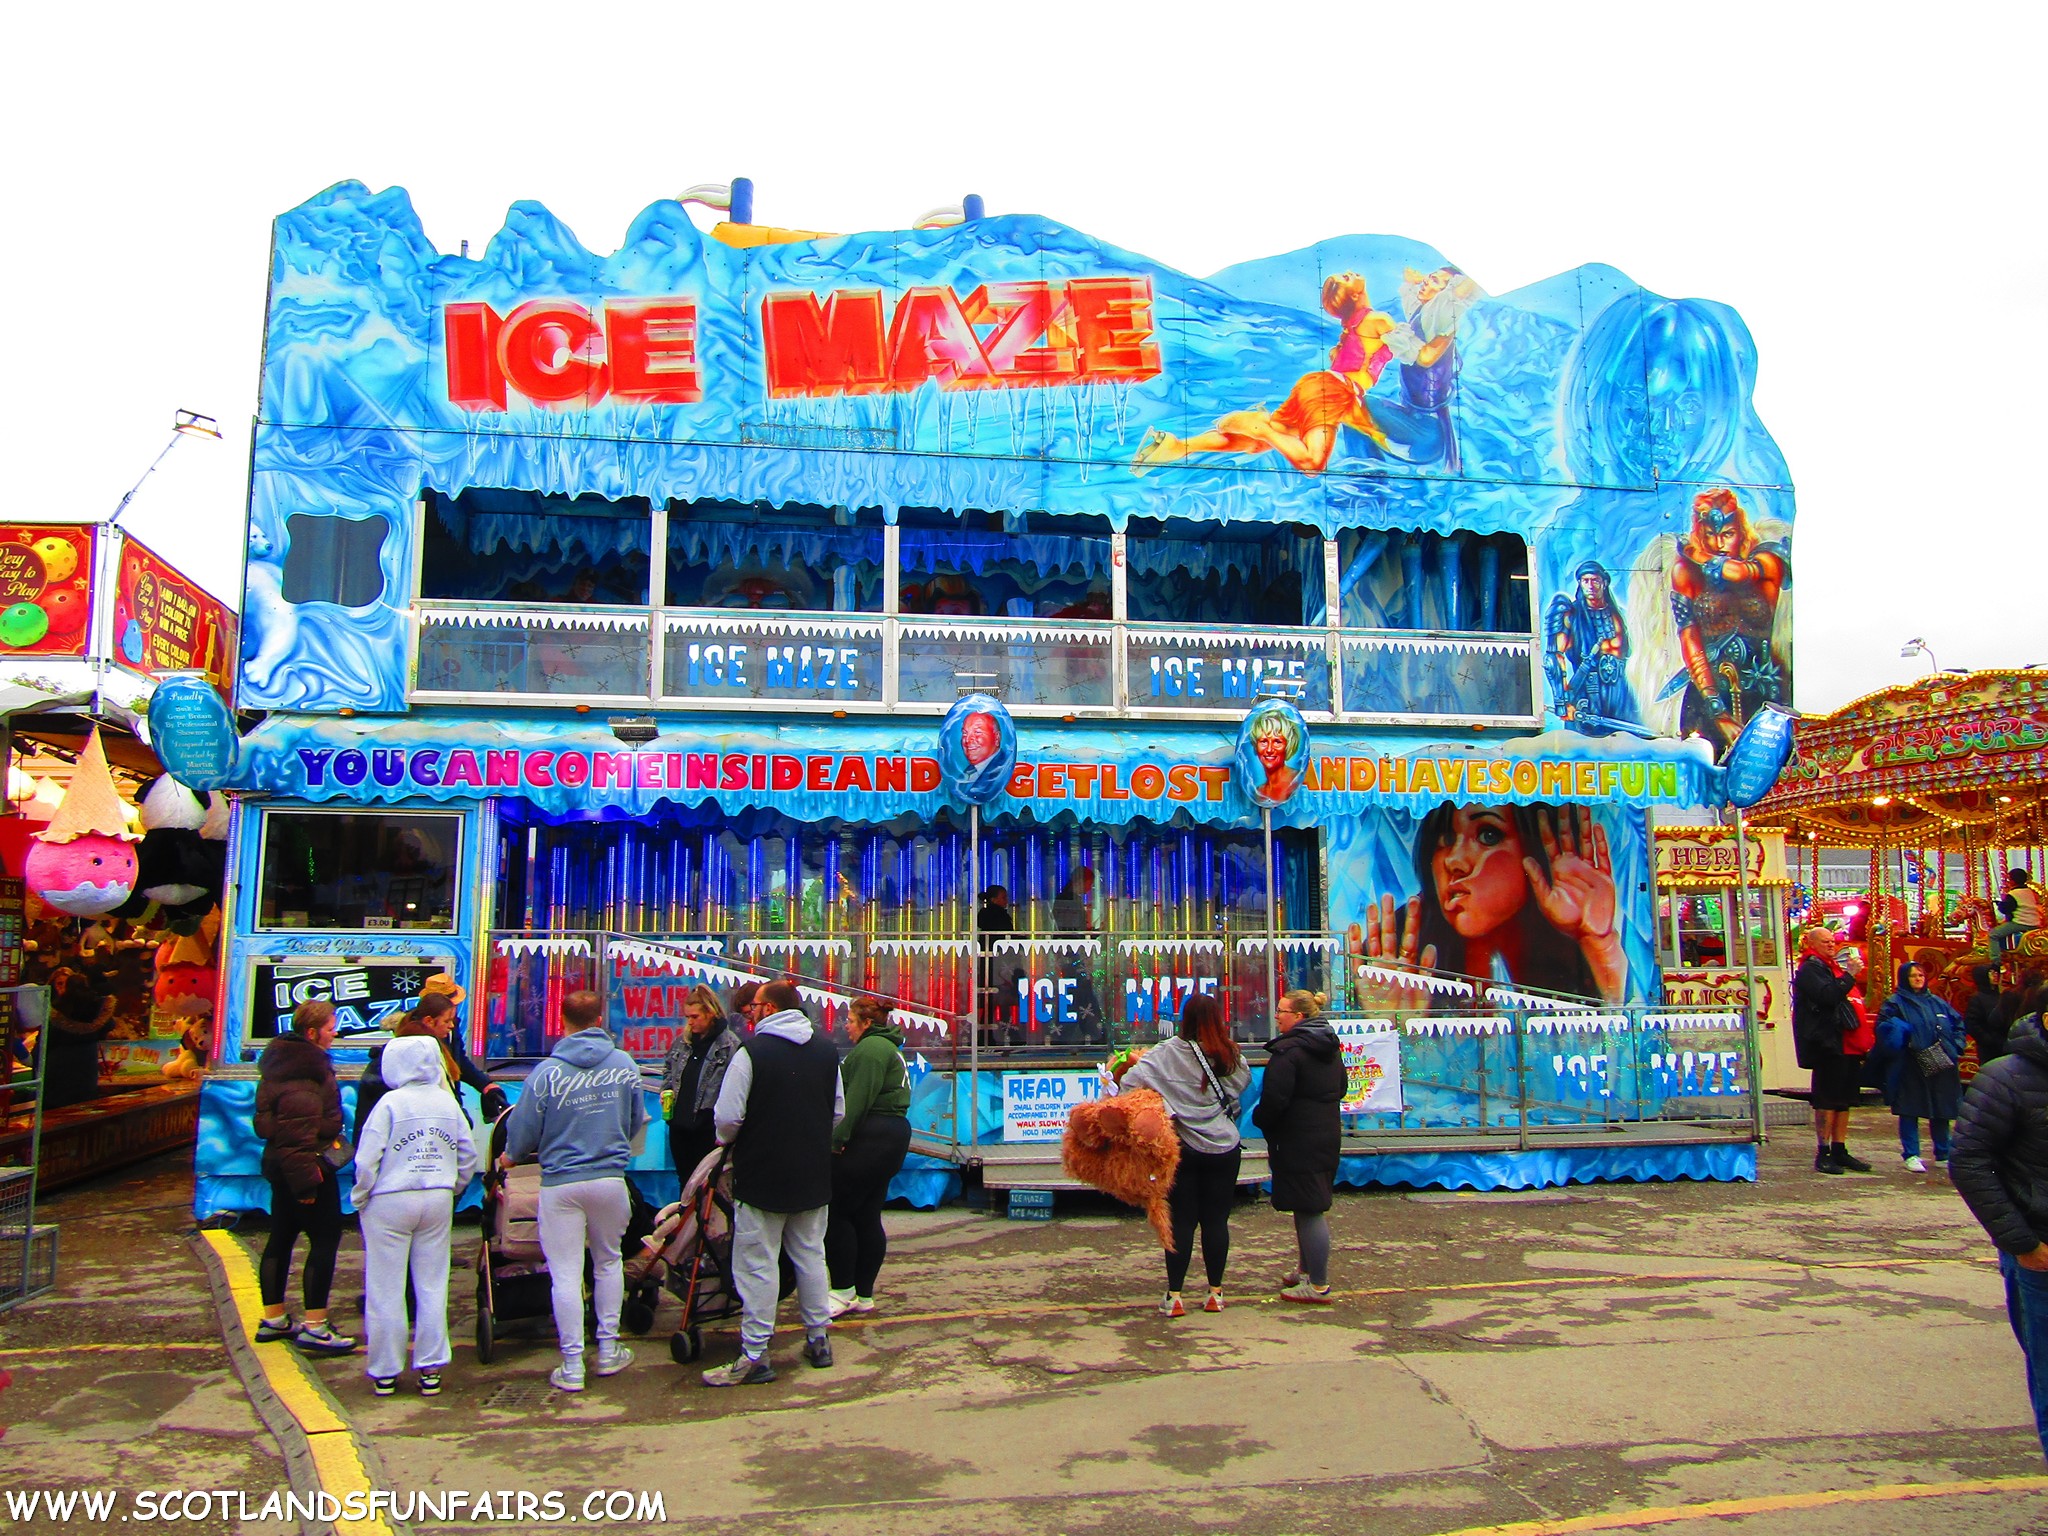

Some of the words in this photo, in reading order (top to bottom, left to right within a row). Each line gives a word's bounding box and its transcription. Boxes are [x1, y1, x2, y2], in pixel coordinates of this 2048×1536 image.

[446, 295, 701, 411] ICE
[761, 275, 1161, 398] MAZE
[24, 566, 36, 578] to
[3, 581, 39, 600] Play
[688, 643, 747, 687] ICE
[766, 645, 859, 689] MAZE
[1150, 655, 1204, 698] ICE
[1221, 658, 1306, 699] MAZE
[377, 941, 392, 954] &
[276, 972, 370, 1008] ICE
[623, 985, 690, 1018] WAIT
[1018, 977, 1077, 1022] ICE
[1664, 988, 1749, 1010] LLIS'S
[278, 997, 421, 1034] AZ
[1343, 1056, 1360, 1064] RLD
[1553, 1055, 1610, 1101] ICE
[1651, 1051, 1743, 1098] MAZE
[1008, 1077, 1066, 1101] READ
[393, 1129, 424, 1151] DSGN
[429, 1127, 457, 1150] STUDIO
[1011, 1195, 1022, 1203] ICE
[1024, 1195, 1044, 1203] MAZE
[1011, 1209, 1025, 1217] ICE
[1027, 1209, 1050, 1218] MAZE
